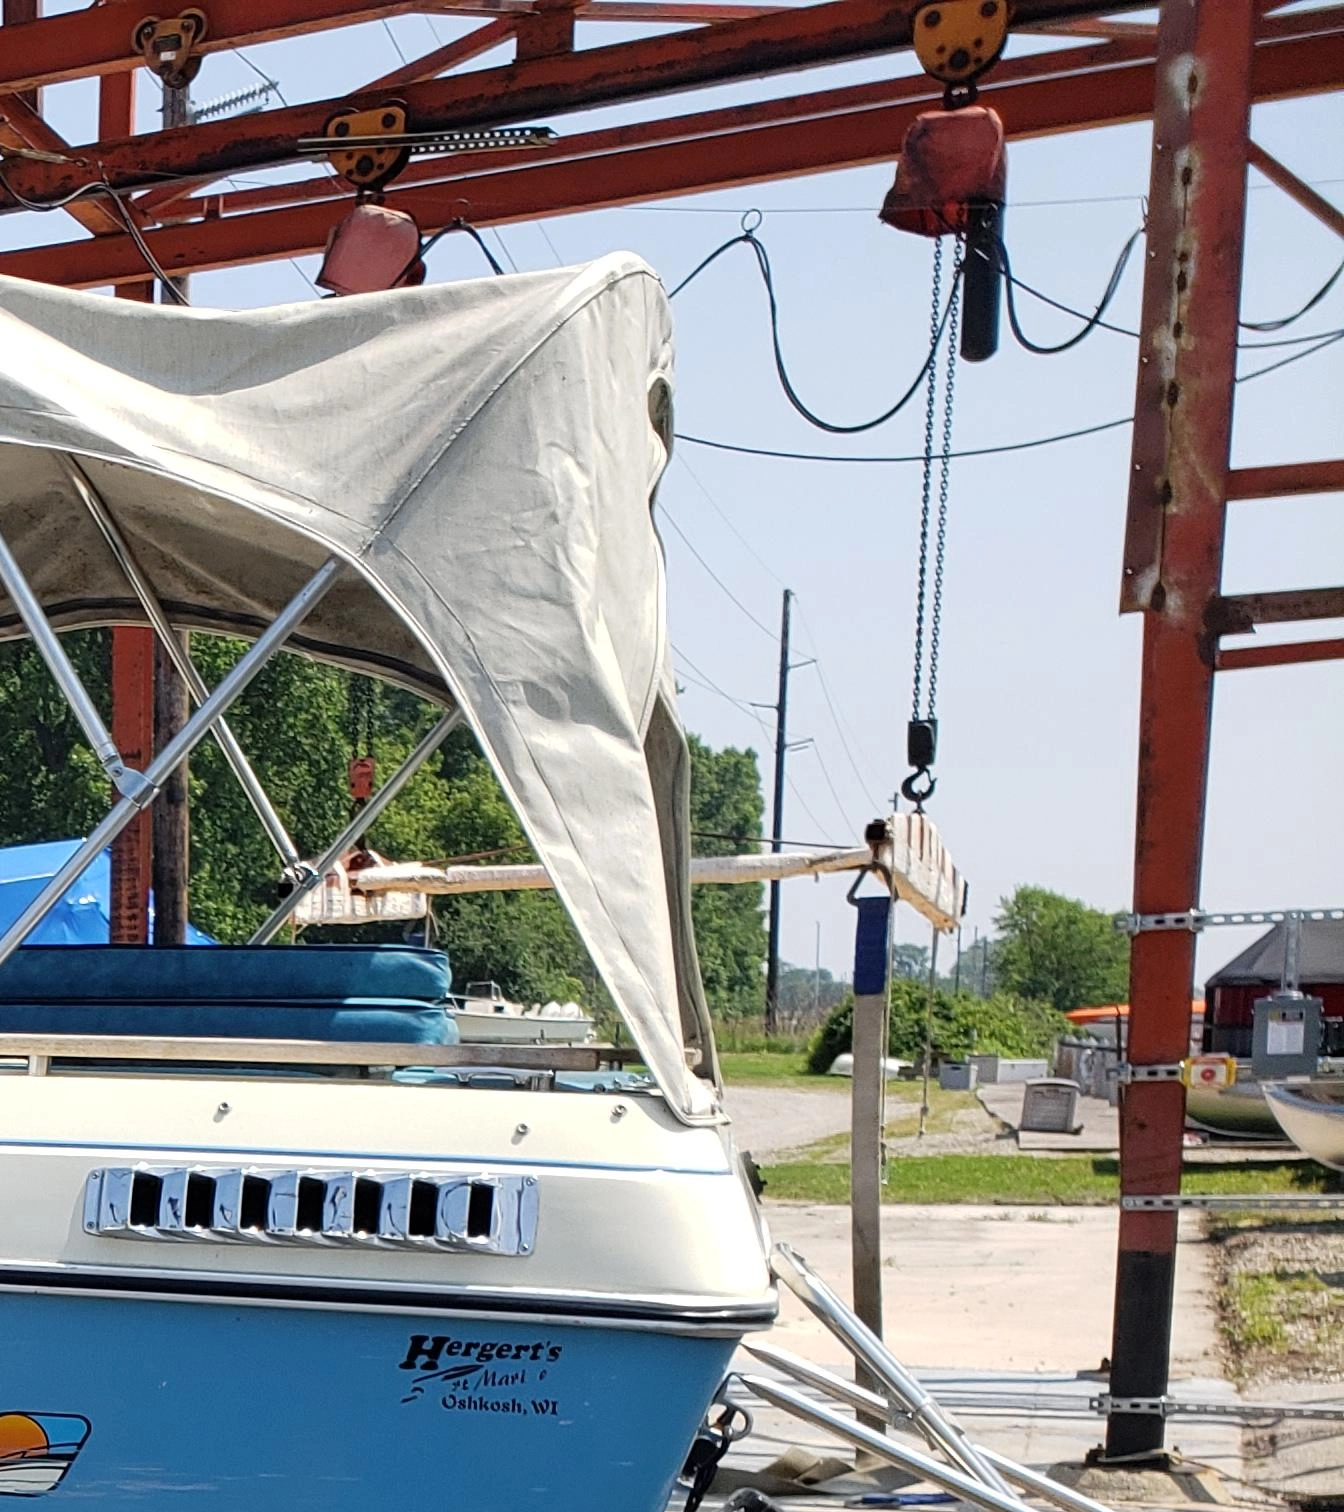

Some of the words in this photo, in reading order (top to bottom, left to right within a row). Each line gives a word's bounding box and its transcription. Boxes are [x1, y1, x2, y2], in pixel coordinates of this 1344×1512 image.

[398, 1335, 563, 1370] Hergert's
[441, 1394, 527, 1416] Oshkosh,
[531, 1400, 559, 1416] WI
